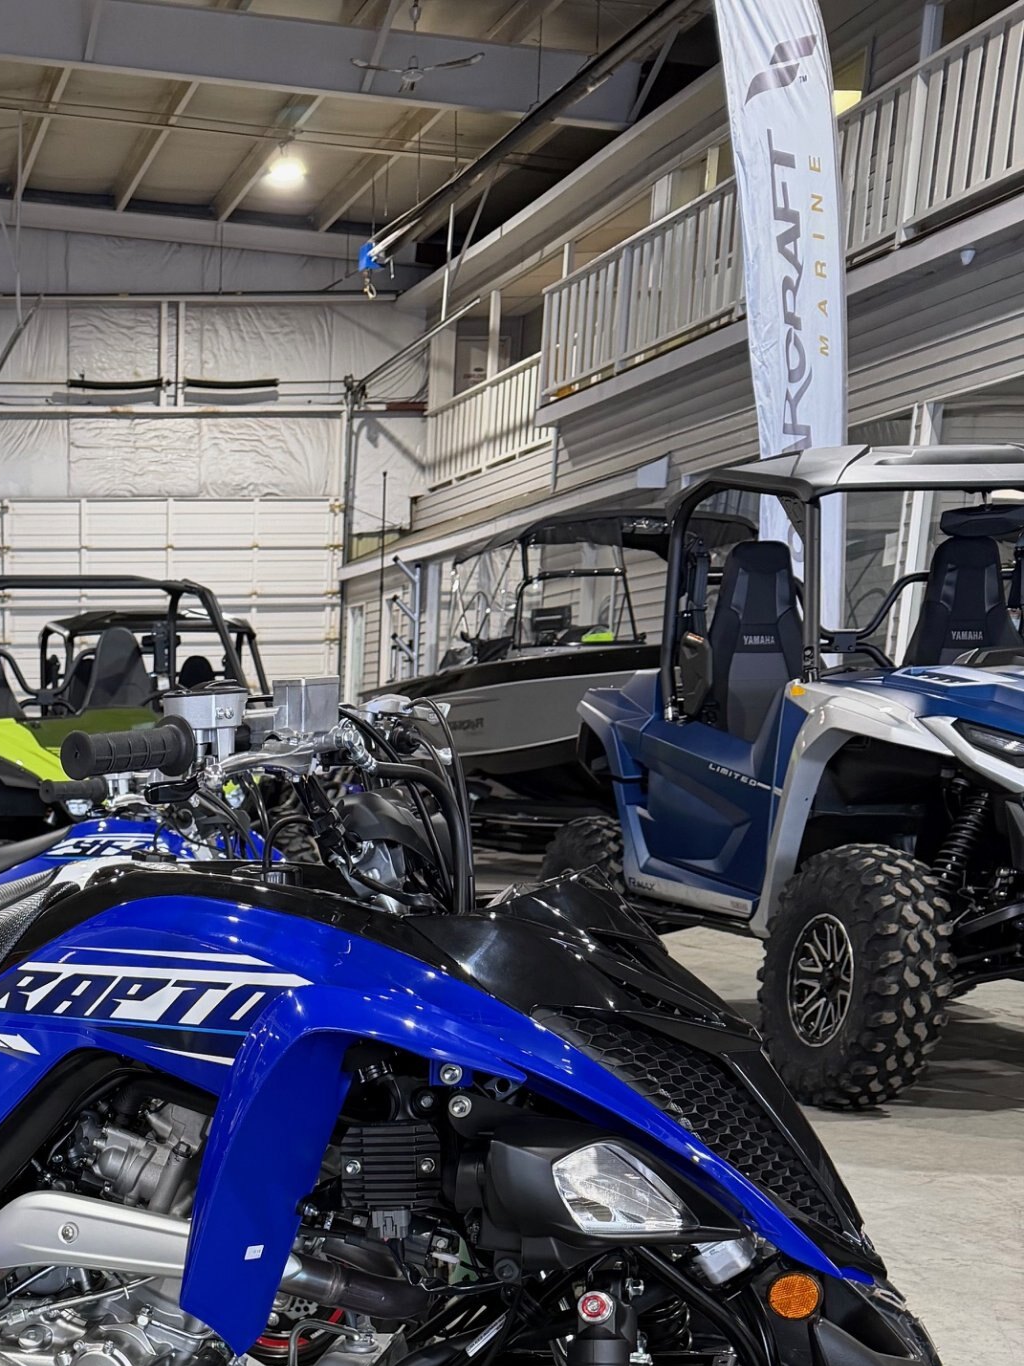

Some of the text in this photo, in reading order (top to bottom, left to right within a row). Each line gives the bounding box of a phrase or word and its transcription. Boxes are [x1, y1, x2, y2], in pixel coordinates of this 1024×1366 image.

[809, 155, 829, 357] MARINE
[766, 128, 813, 563] RCRAFT
[743, 635, 775, 645] YAMAHA
[951, 631, 983, 641] YAMAHA
[708, 763, 757, 787] LIMITED
